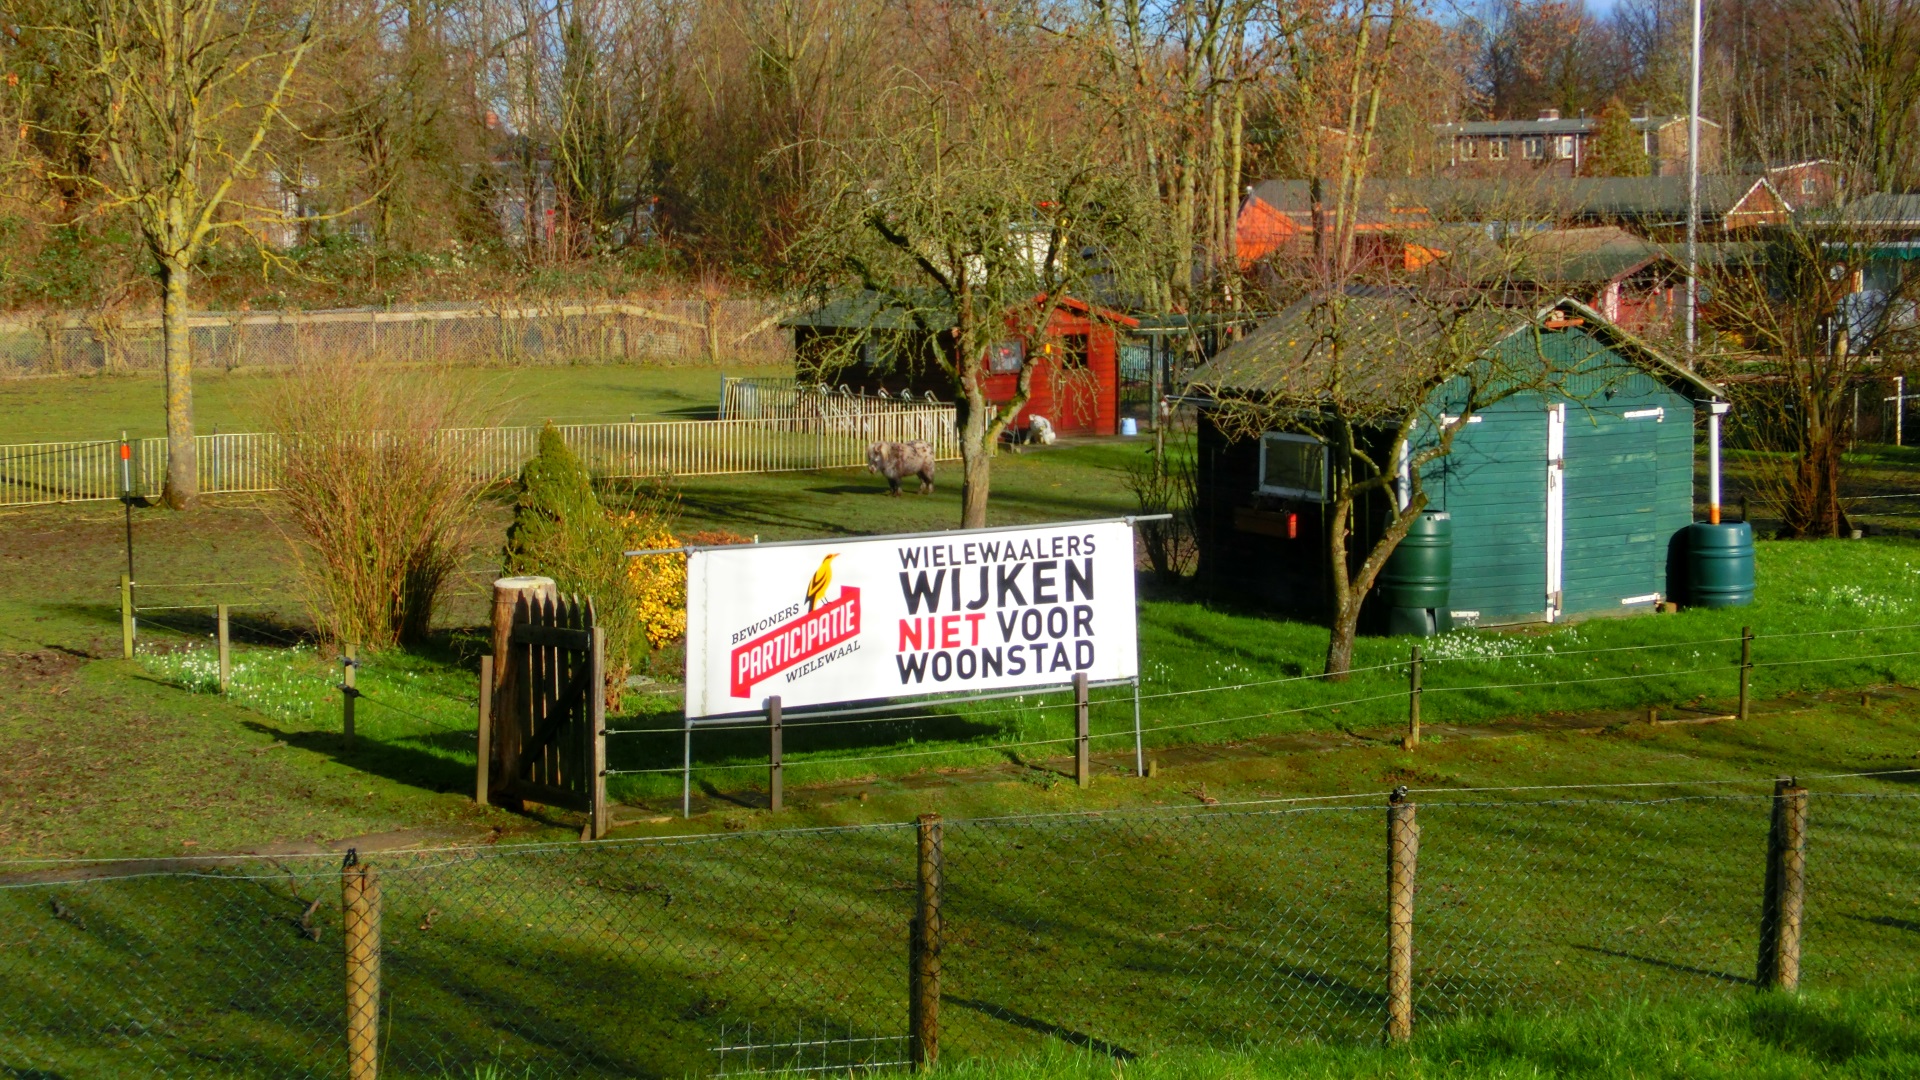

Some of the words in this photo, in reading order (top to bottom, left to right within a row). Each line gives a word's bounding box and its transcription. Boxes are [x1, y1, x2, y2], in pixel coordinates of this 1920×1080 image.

[898, 534, 1096, 569] WIELEWAALERS
[899, 557, 1095, 615] WIJKEN
[731, 602, 800, 645] BEWONERS
[738, 599, 856, 685] PARTICIPATIE
[899, 612, 985, 652] NIET
[997, 604, 1095, 642] VOOR
[786, 640, 861, 683] WIELEWAAL
[896, 639, 1096, 685] WOONSTAD
